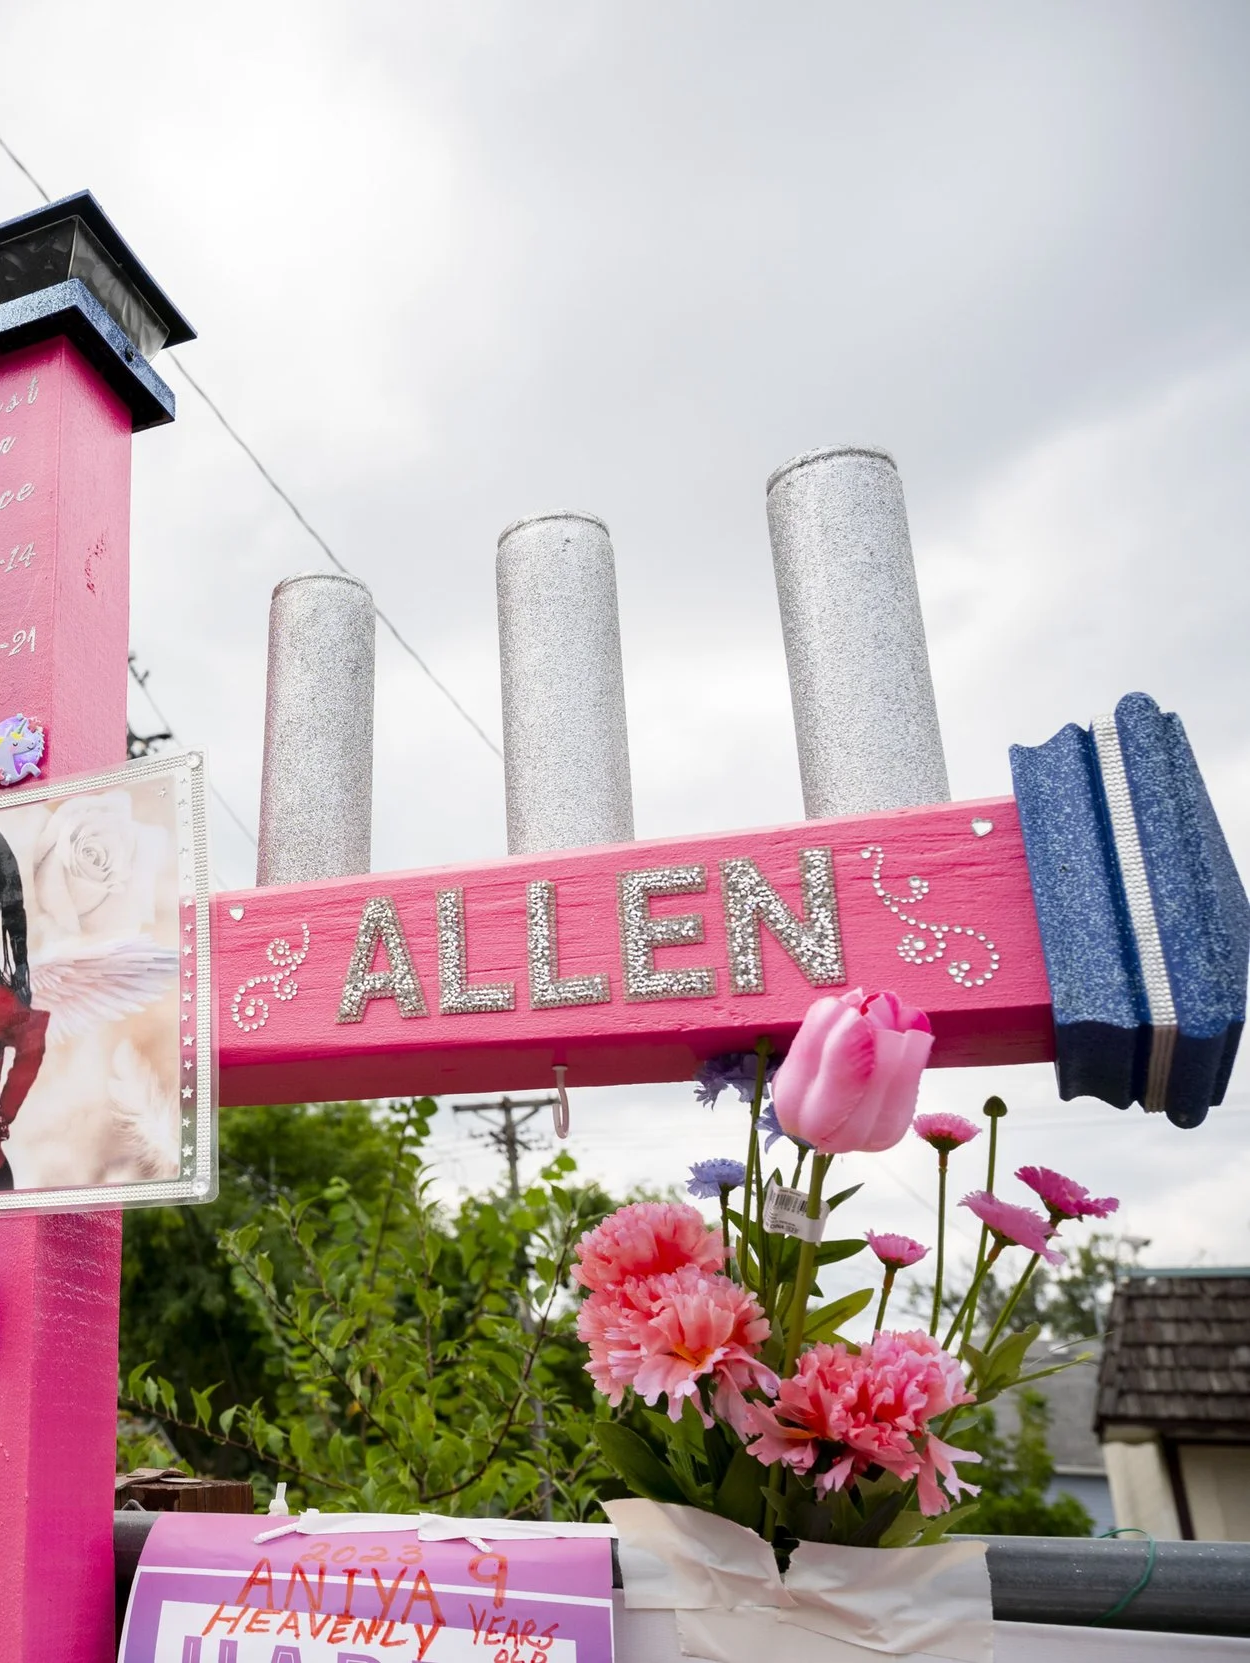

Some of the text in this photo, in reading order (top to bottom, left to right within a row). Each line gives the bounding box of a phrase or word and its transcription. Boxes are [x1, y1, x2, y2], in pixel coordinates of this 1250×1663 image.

[336, 846, 848, 1025] ALLEN
[300, 1540, 425, 1566] 2023
[235, 1553, 509, 1627] ANIYA 9
[201, 1601, 447, 1661] HEAVENLY
[467, 1602, 560, 1651] YEARS
